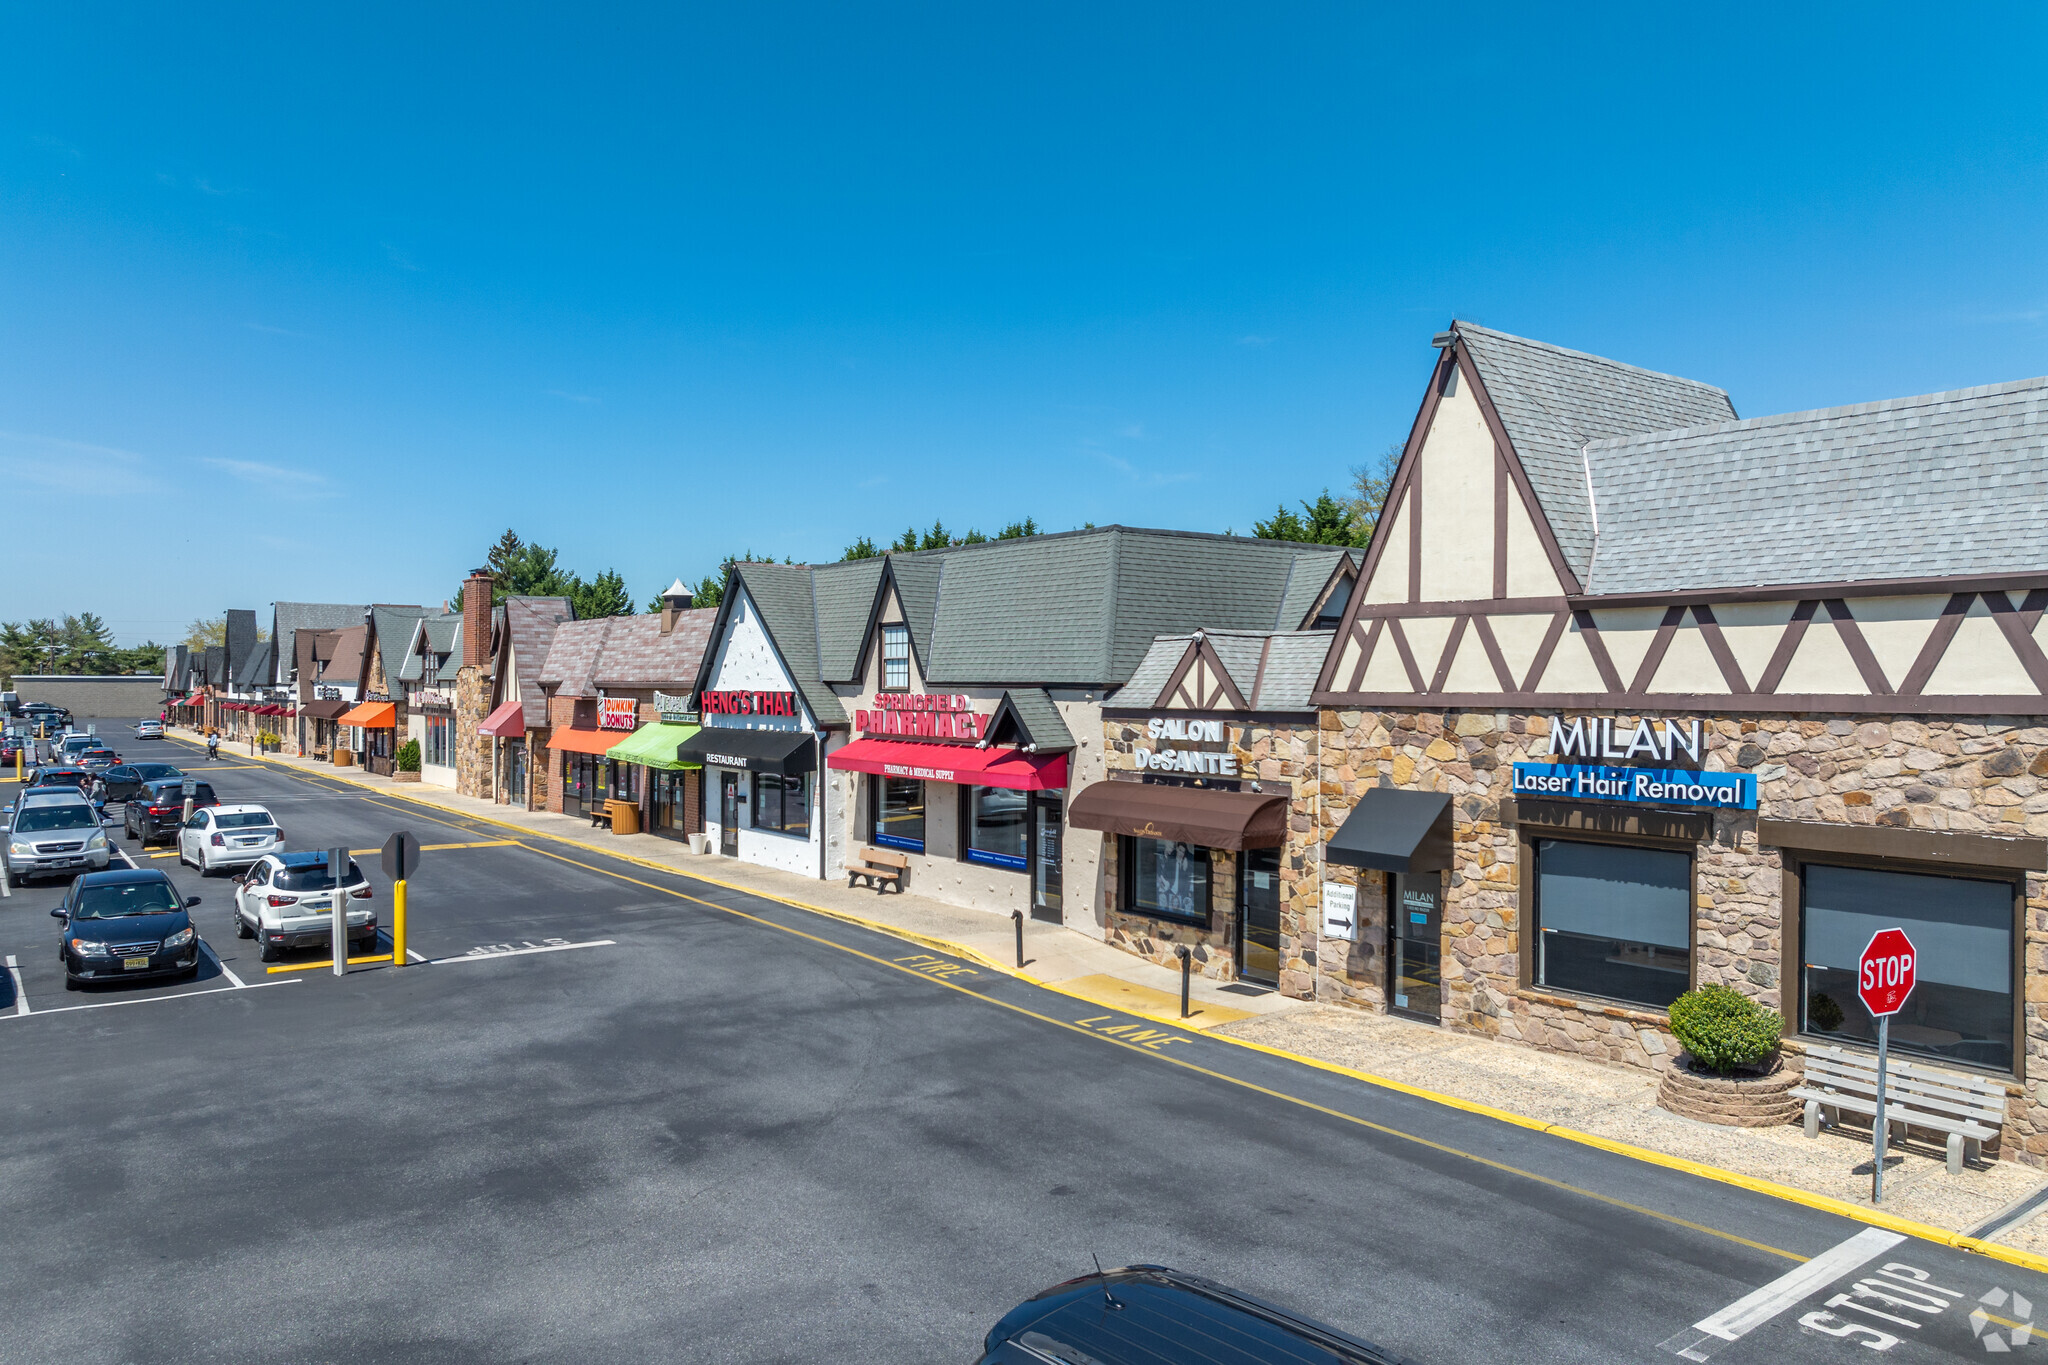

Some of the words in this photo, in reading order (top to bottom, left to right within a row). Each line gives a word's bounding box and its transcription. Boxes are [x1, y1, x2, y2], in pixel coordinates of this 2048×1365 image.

[606, 698, 635, 713] DUNKIN'
[701, 690, 752, 715] HENG'S
[753, 691, 795, 717] THAI
[874, 693, 966, 712] SPRINGFIELD
[606, 713, 633, 730] DONUTS
[856, 710, 989, 739] PHARMACY
[1148, 718, 1224, 742] SALON
[1549, 716, 1699, 762] MILAN
[706, 753, 747, 767] RESTAURANT
[884, 764, 909, 776] PHARMACY
[909, 766, 913, 776] &
[914, 767, 935, 779] MEDICAL
[936, 770, 954, 780] SUPPLY
[1135, 748, 1237, 775] DeSANTE
[1514, 768, 1571, 792] Laser
[1578, 771, 1628, 796] Hair
[1636, 775, 1741, 804] Removal
[1326, 889, 1354, 900] Additional
[1329, 900, 1351, 912] Parking
[1403, 890, 1434, 904] MILAN
[893, 954, 979, 979] FIRE
[1863, 954, 1912, 991] STOP
[1074, 1015, 1193, 1050] LANE
[1798, 1262, 1965, 1351] STOP
